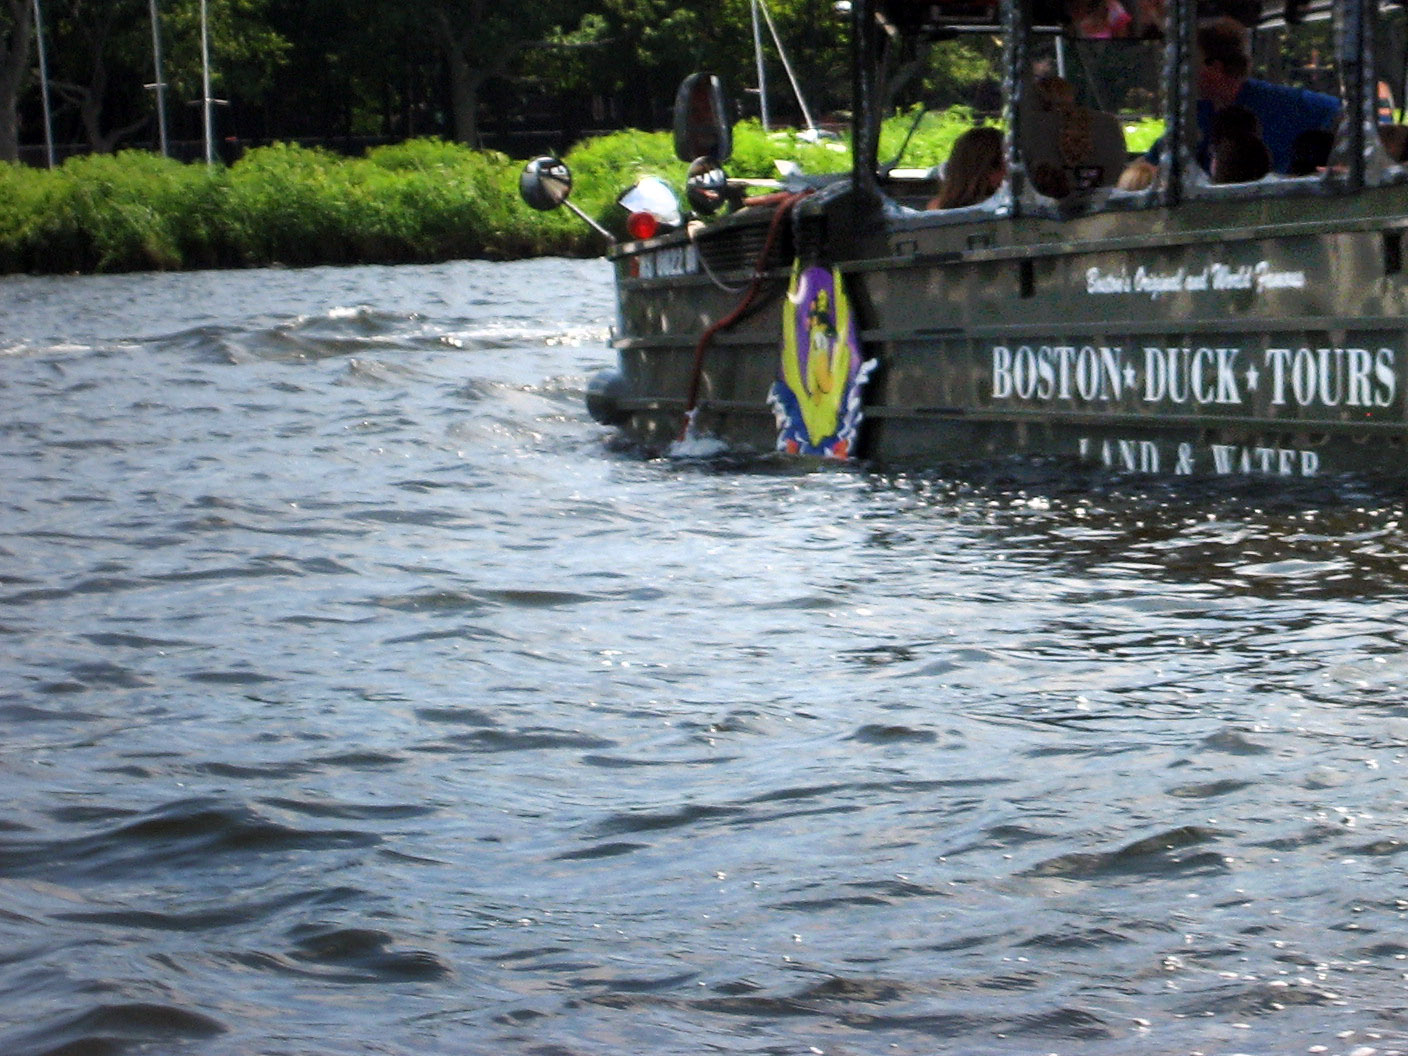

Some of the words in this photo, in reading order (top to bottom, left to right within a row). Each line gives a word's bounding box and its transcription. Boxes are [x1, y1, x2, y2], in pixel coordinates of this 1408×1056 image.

[1184, 266, 1209, 292] and
[992, 345, 1123, 401] BOSTON
[1143, 346, 1242, 405] DUCK
[1264, 347, 1397, 408] TOURS
[1173, 442, 1196, 475] &
